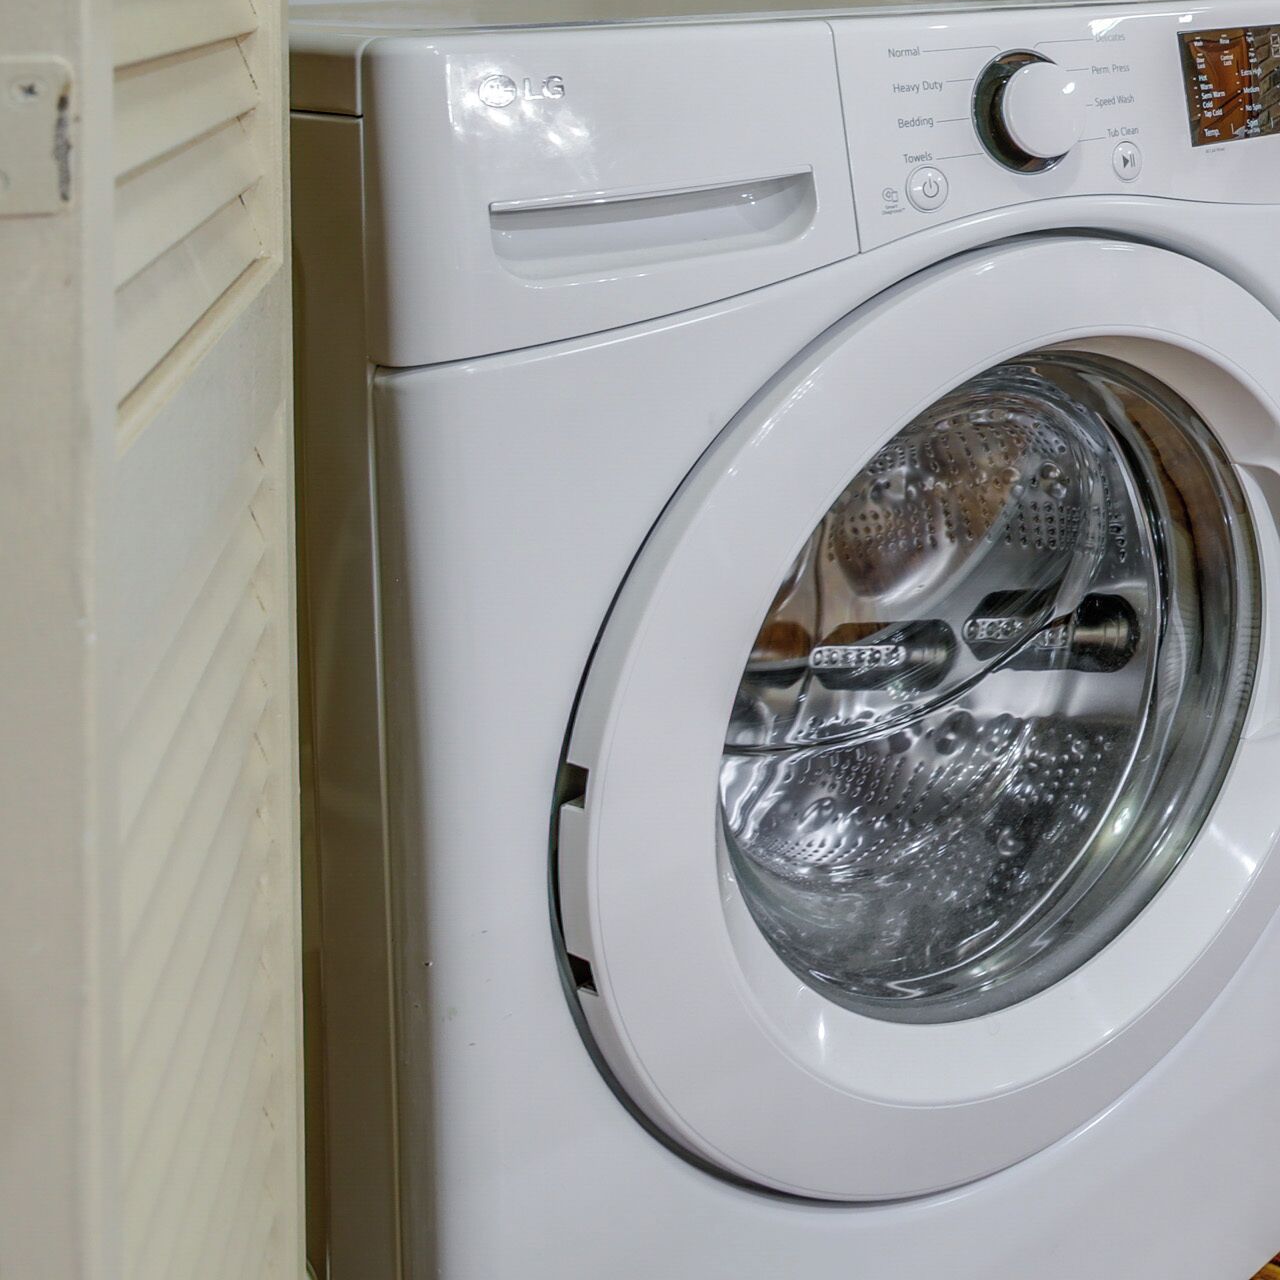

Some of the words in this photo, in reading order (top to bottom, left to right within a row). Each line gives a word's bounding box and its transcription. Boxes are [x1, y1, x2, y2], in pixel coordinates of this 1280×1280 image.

[887, 46, 920, 59] Normal
[1112, 64, 1131, 73] Press
[523, 75, 566, 100] LG
[892, 83, 920, 94] Heavy
[922, 80, 943, 92] Duty
[1094, 95, 1116, 108] Speed
[1116, 93, 1135, 104] Wash
[897, 117, 934, 129] Bedding
[1106, 128, 1119, 138] Tub
[1120, 126, 1140, 137] Clean
[903, 152, 933, 164] Towels
